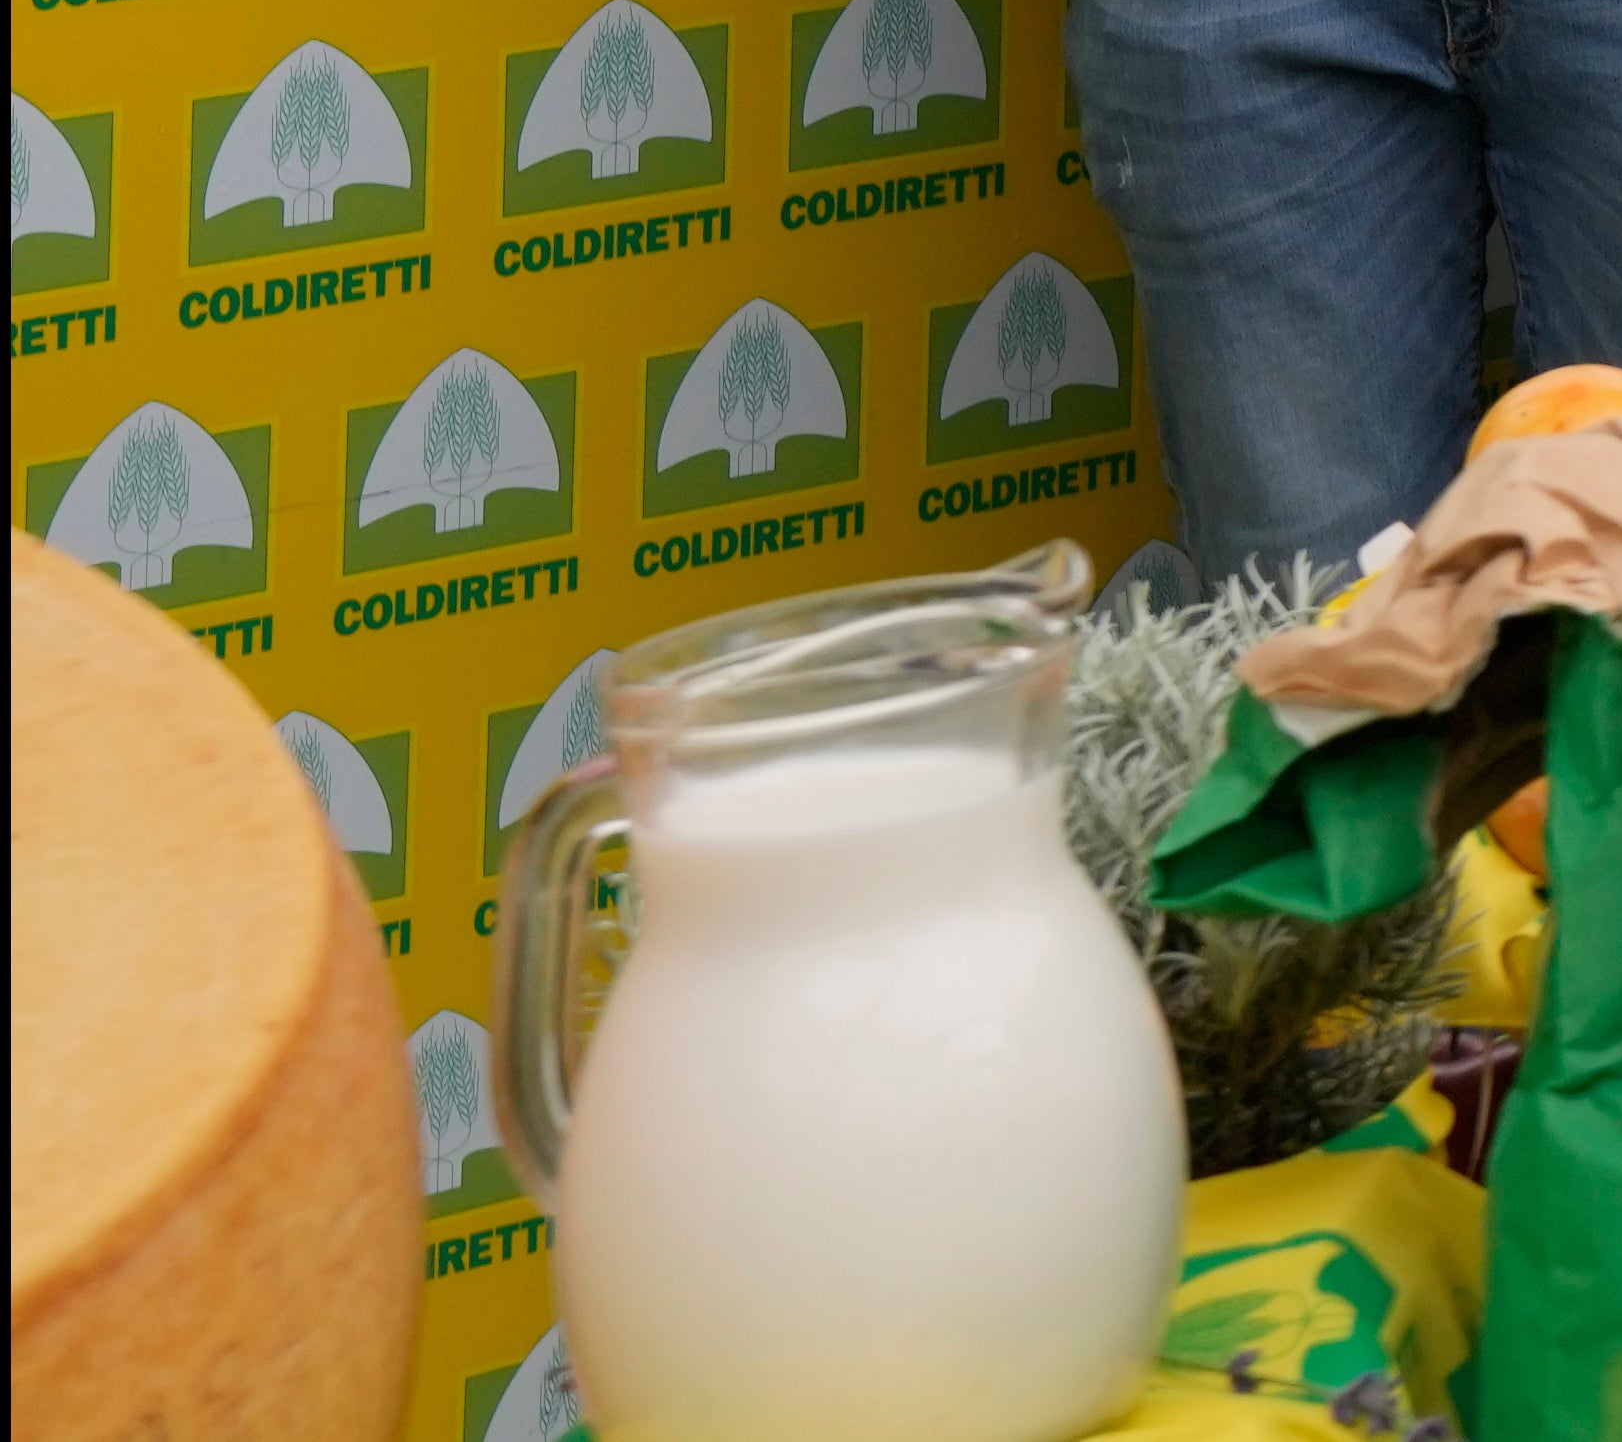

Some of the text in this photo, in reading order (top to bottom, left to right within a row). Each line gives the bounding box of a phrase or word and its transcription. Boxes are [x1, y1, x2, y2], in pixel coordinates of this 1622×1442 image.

[782, 164, 1004, 228] COLDIRETTI
[496, 208, 730, 275] COLDIRETTI
[181, 256, 430, 327] COLDIRETTI
[920, 452, 1135, 521] COLDIRETTI
[635, 504, 863, 576] COLDIRETTI
[335, 558, 577, 634] COLDIRETTI
